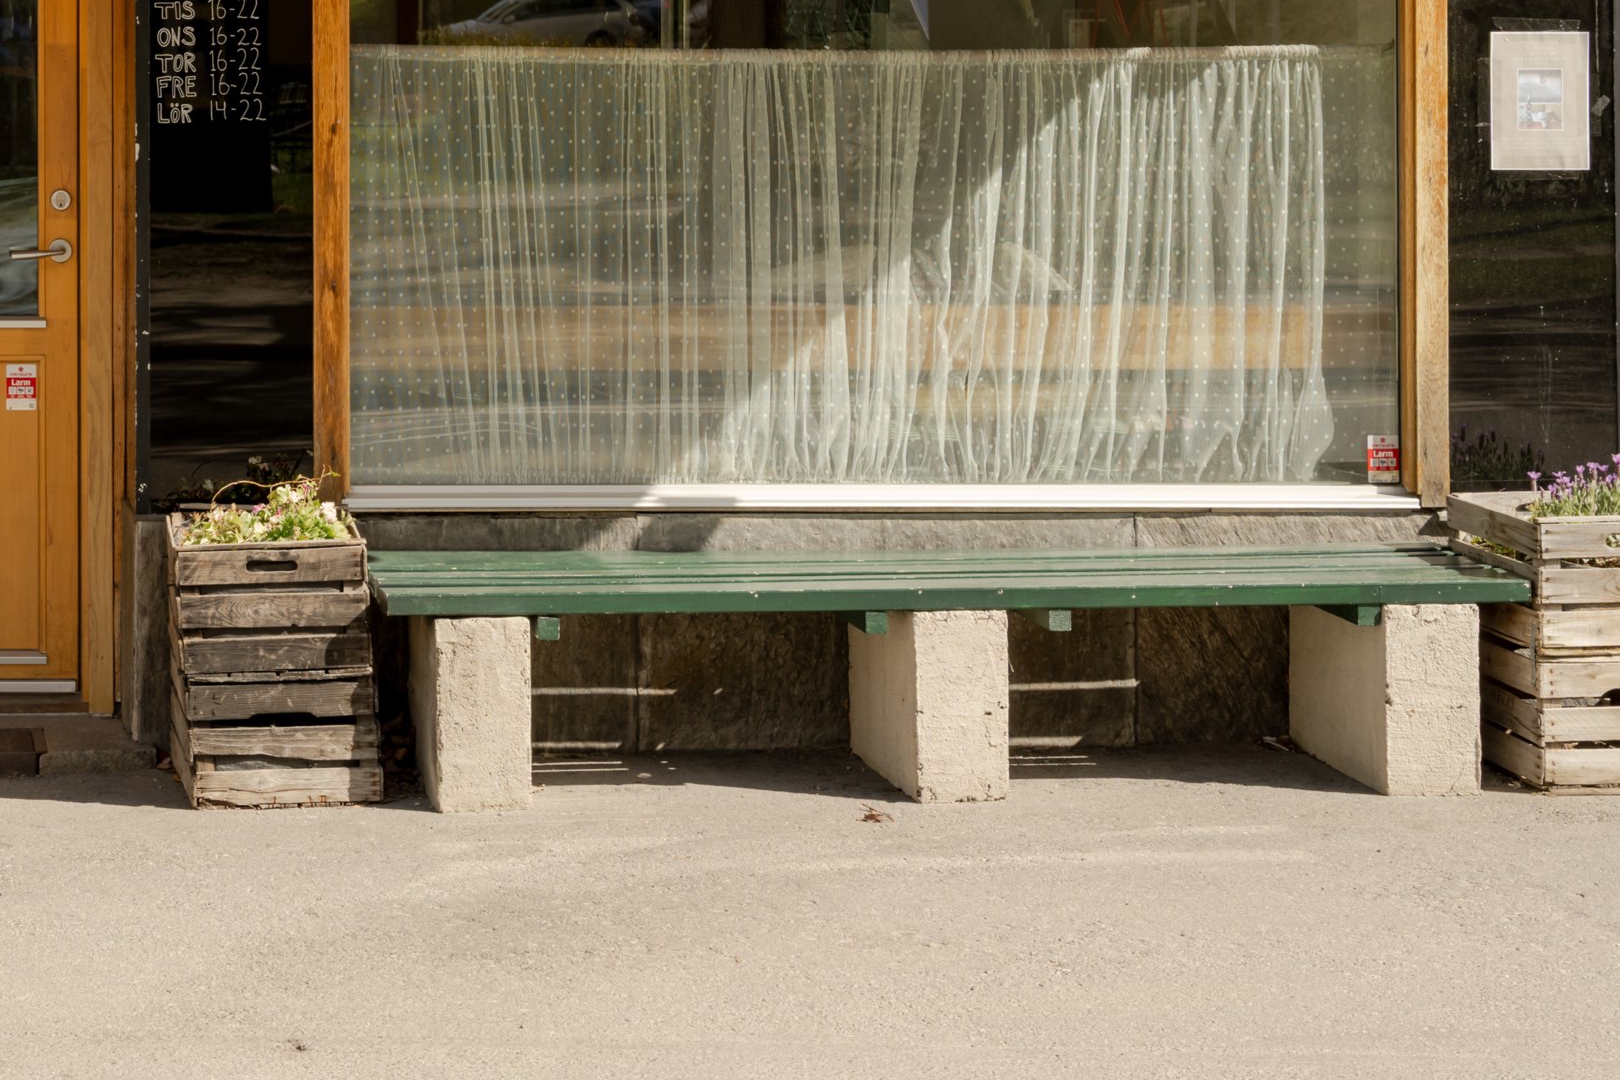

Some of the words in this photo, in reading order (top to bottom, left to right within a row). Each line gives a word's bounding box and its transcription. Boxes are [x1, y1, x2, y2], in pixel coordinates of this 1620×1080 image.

[154, 0, 196, 20] TIS
[156, 26, 196, 47] ONS
[209, 26, 262, 46] 16-22
[155, 52, 196, 73] TOR
[209, 47, 262, 71] 16-22
[156, 76, 197, 98] FRE
[210, 72, 263, 96] 16-22
[157, 102, 193, 124] LÖR
[210, 98, 267, 121] 14-22
[1373, 450, 1394, 458] Larm
